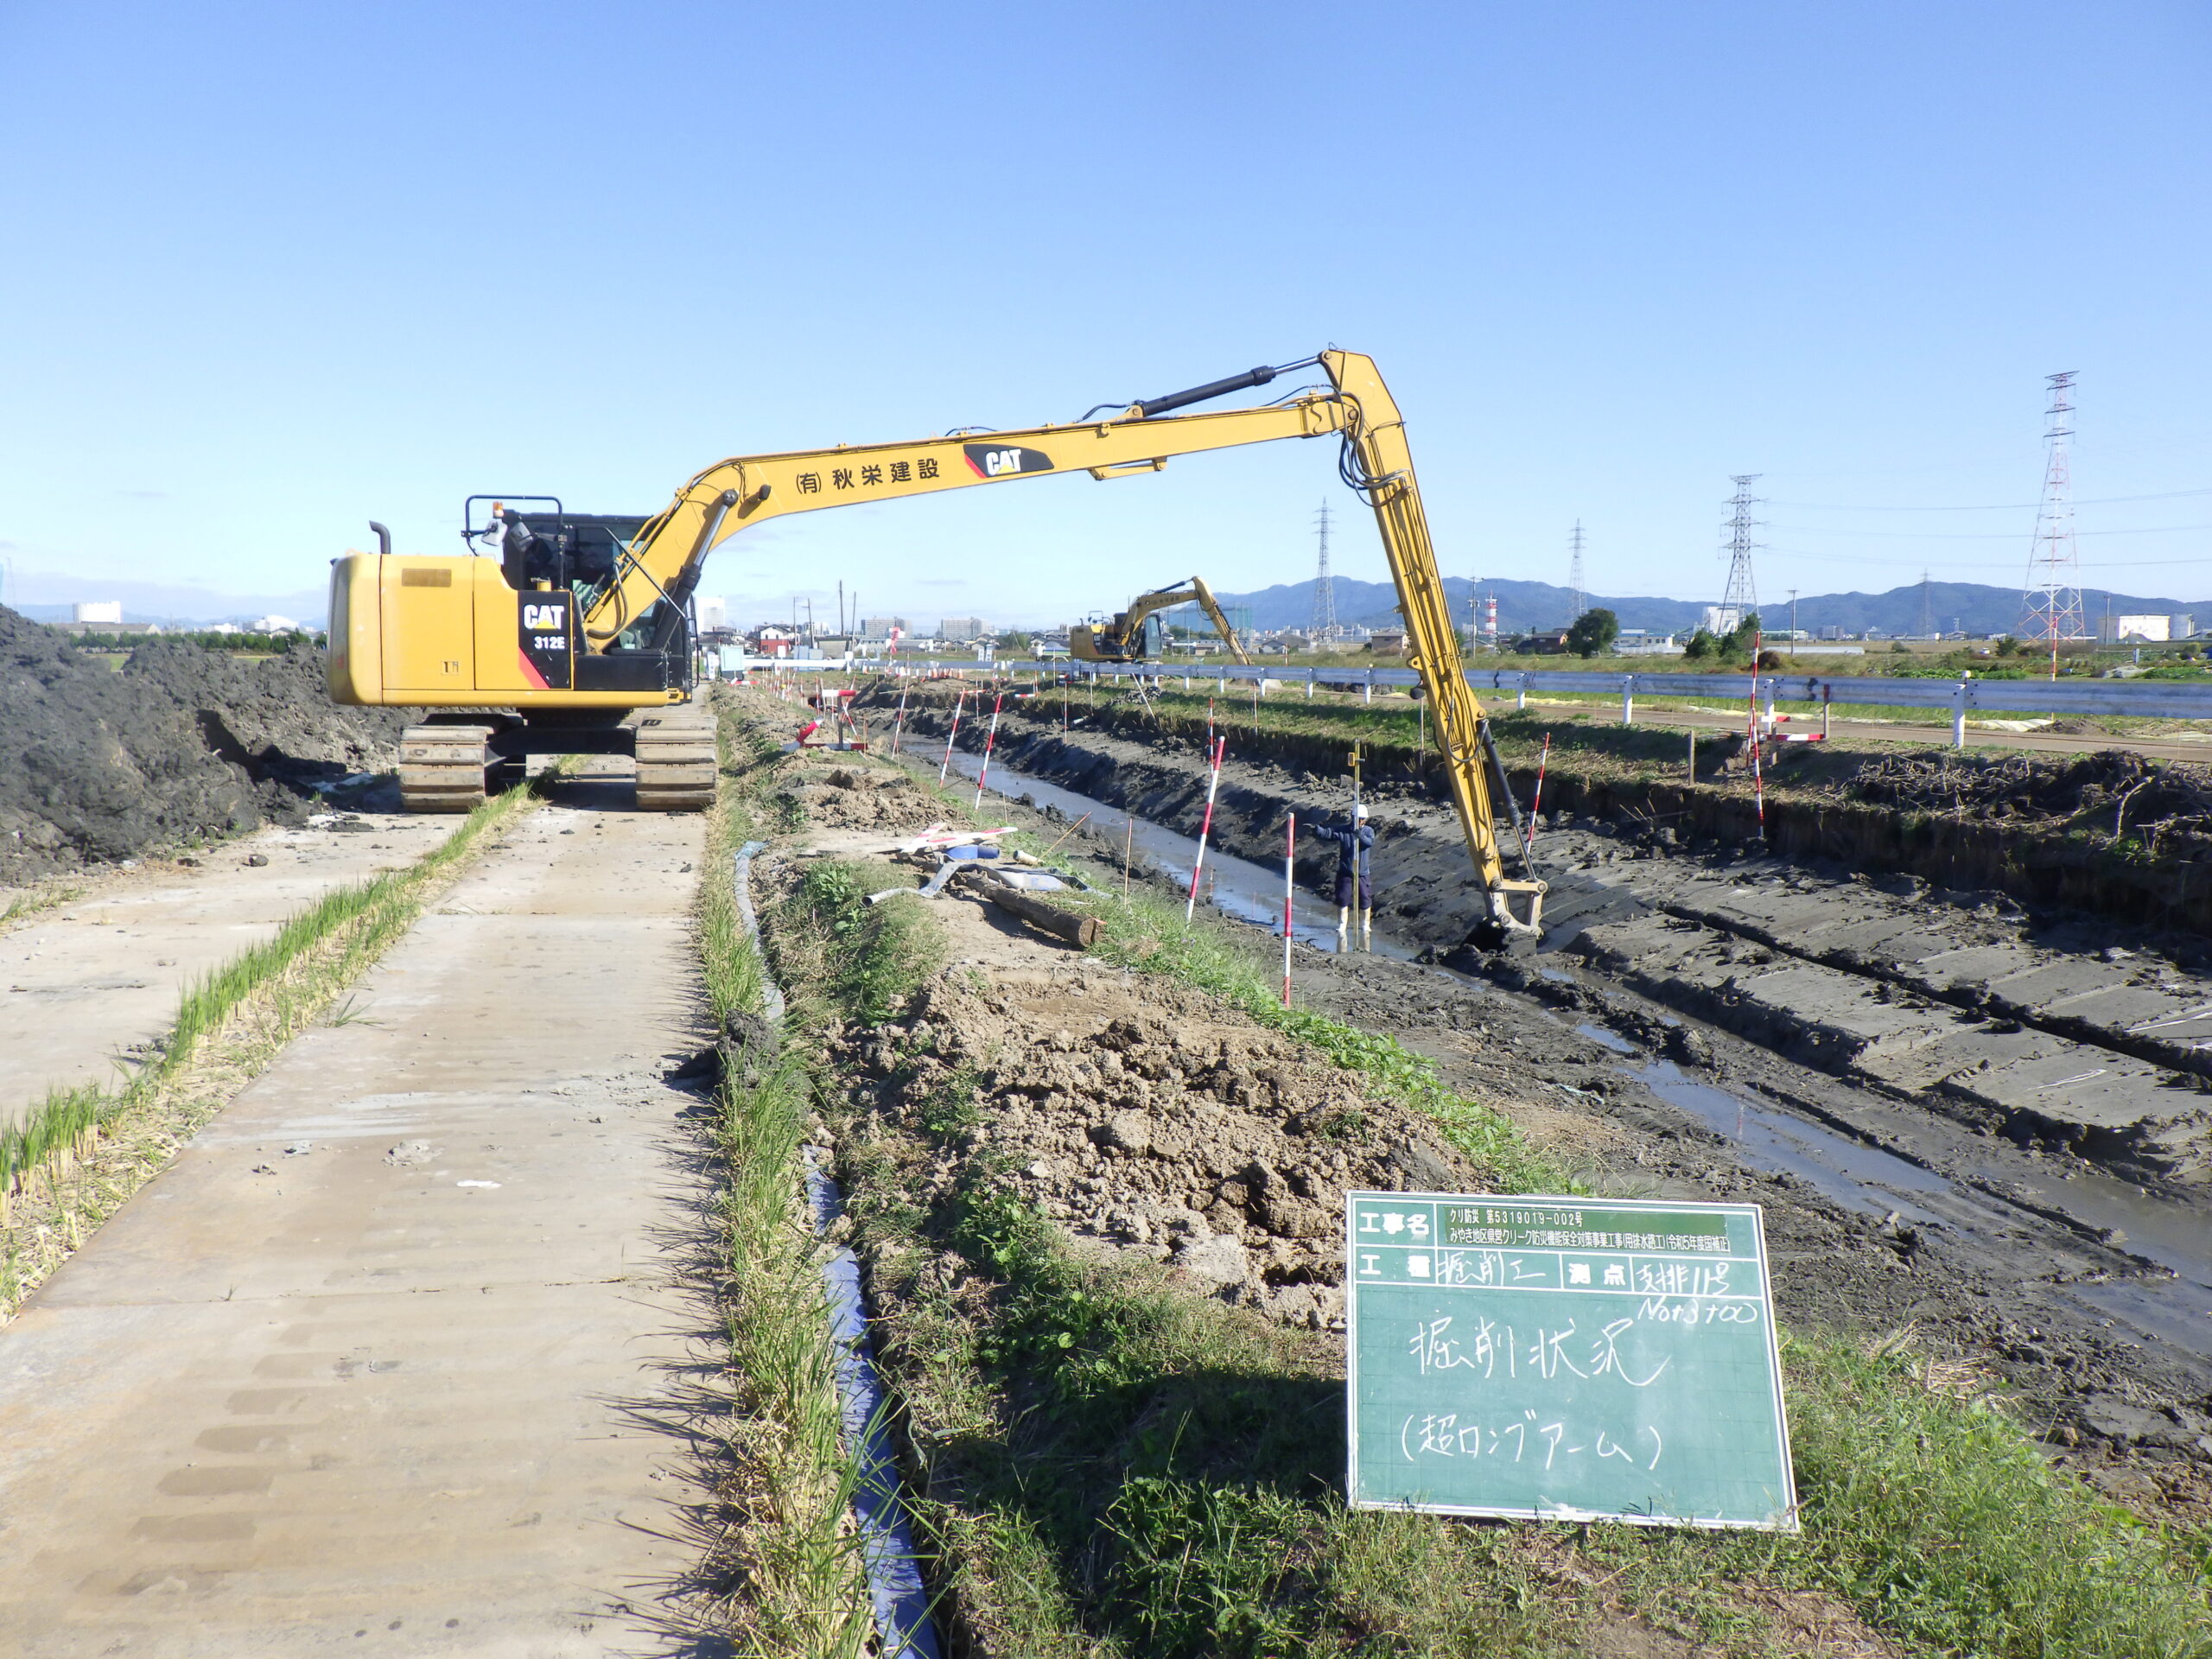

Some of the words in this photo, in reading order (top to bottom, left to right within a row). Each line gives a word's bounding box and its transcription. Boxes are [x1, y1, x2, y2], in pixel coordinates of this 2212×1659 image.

[985, 448, 1021, 474] CAT
[524, 604, 564, 630] CAT
[534, 636, 565, 650] 312E
[1358, 1212, 1429, 1236] 工事名
[1410, 1316, 1672, 1387] 掘削状況
